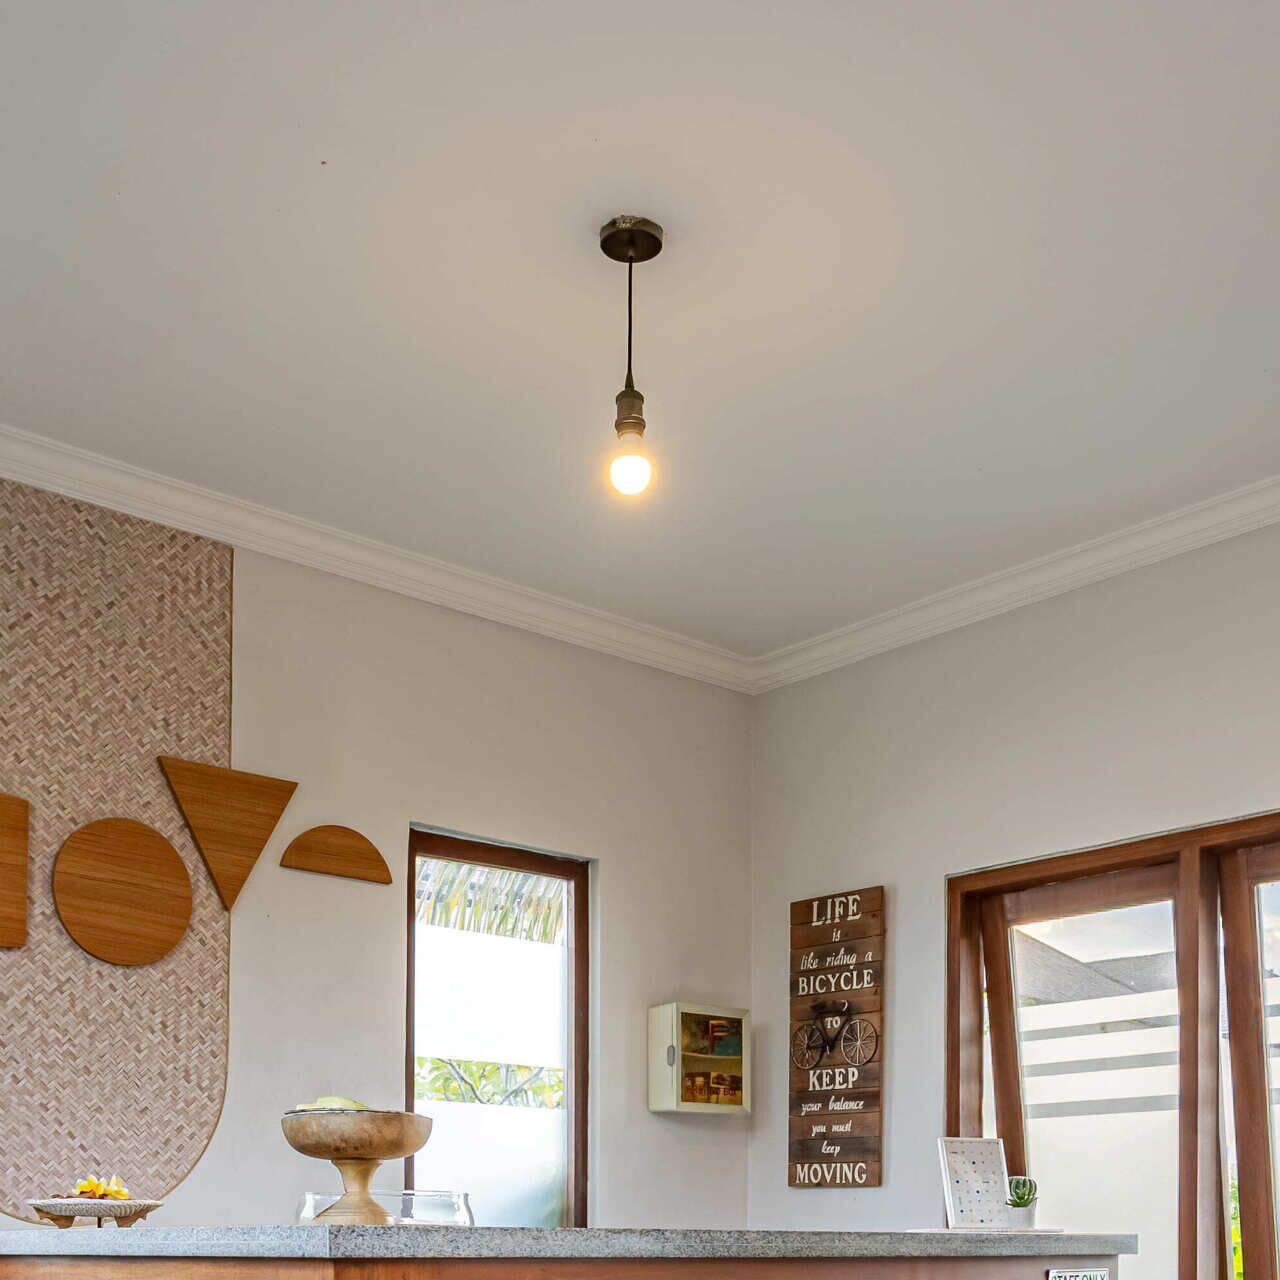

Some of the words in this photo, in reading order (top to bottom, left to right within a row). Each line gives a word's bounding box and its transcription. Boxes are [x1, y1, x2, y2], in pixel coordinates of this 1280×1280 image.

[811, 894, 862, 926] LIFE
[832, 928, 841, 942] is
[800, 952, 818, 970] like
[826, 946, 857, 970] riding
[864, 951, 873, 962] a
[798, 968, 874, 995] BICYCLE
[825, 1016, 840, 1029] TO
[808, 1067, 859, 1091] KEEP
[801, 1102, 822, 1116] your
[828, 1095, 864, 1111] balance
[811, 1123, 827, 1137] you
[831, 1120, 853, 1132] must
[821, 1140, 841, 1157] keep
[795, 1162, 867, 1184] MOVING
